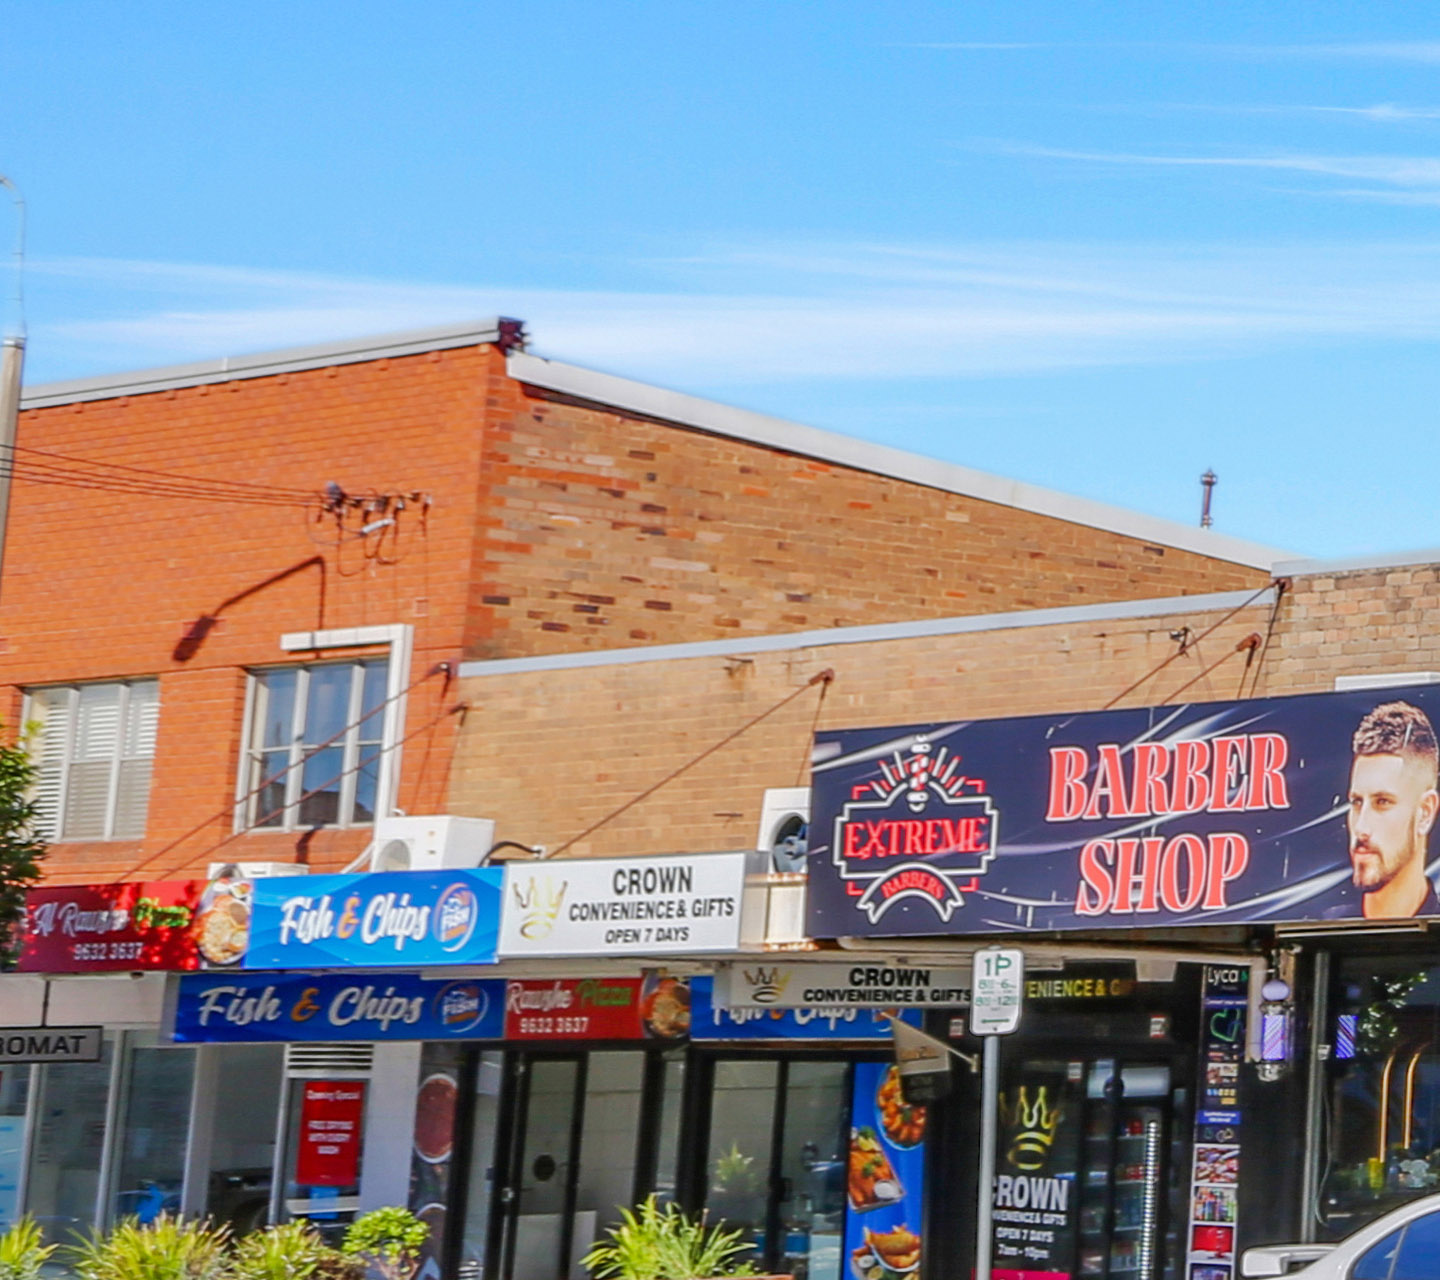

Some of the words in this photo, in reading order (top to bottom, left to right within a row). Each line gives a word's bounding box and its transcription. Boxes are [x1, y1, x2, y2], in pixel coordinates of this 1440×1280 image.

[1046, 734, 1290, 823] BARBER
[844, 818, 988, 858] EXTREME
[613, 867, 693, 895] CROWN
[881, 870, 945, 899] BARBERS
[1075, 834, 1249, 916] SHOP
[280, 895, 334, 945] Fish
[337, 897, 360, 939] &
[362, 893, 431, 950] Chips
[570, 901, 674, 921] CONVENIENCE
[692, 898, 734, 917] GIFTS
[605, 929, 640, 944] OPEN
[644, 928, 653, 942] 7
[656, 927, 689, 942] DAYS
[850, 968, 930, 987] CROWN
[1025, 979, 1092, 998] ENIENCE
[199, 986, 282, 1027] Fish
[291, 988, 320, 1022] &
[328, 985, 425, 1031] Chips
[803, 989, 912, 1003] CONVENIENCE
[930, 989, 971, 1002] GIFTS
